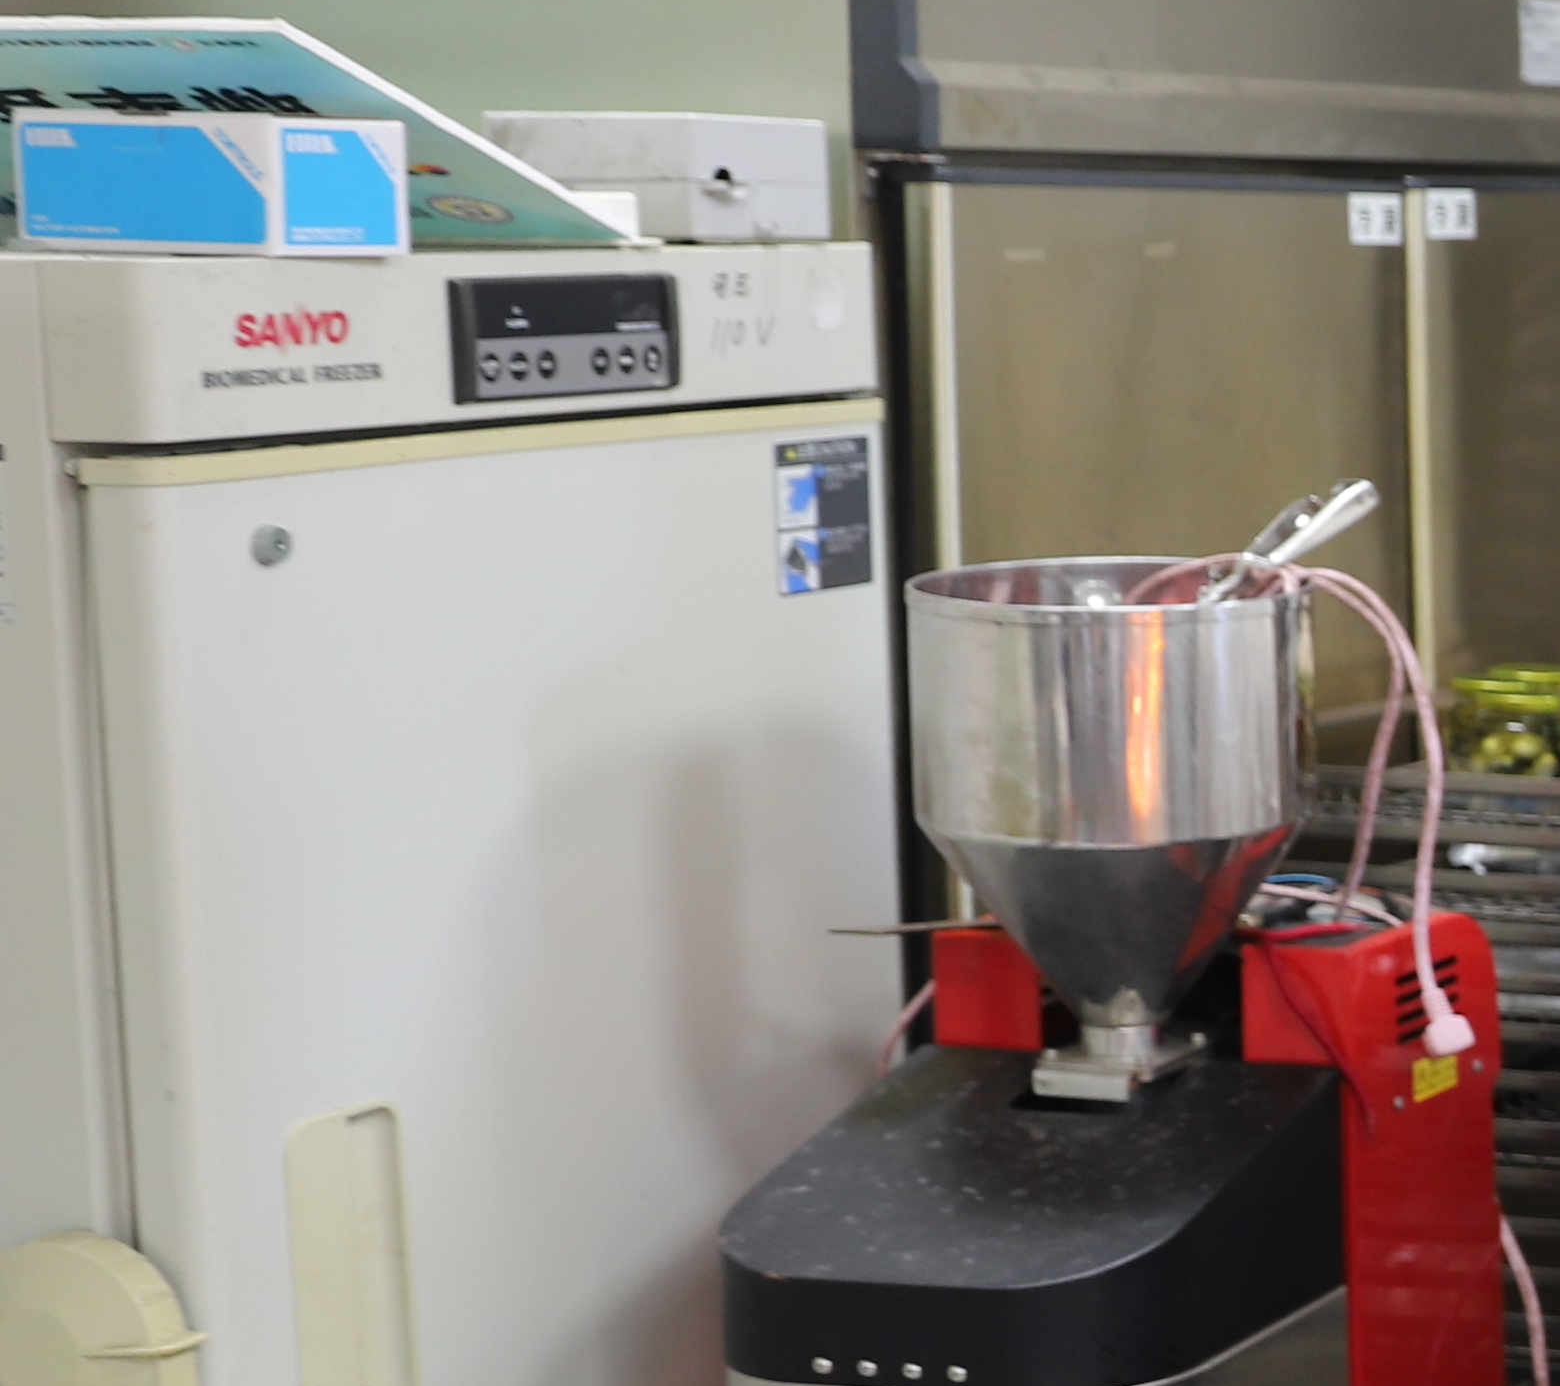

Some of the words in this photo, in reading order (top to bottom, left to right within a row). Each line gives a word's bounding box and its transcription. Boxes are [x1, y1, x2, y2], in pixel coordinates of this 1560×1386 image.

[234, 306, 351, 351] SANYO
[202, 367, 308, 390] BIOMEDICAL
[314, 361, 383, 382] FREEZER
